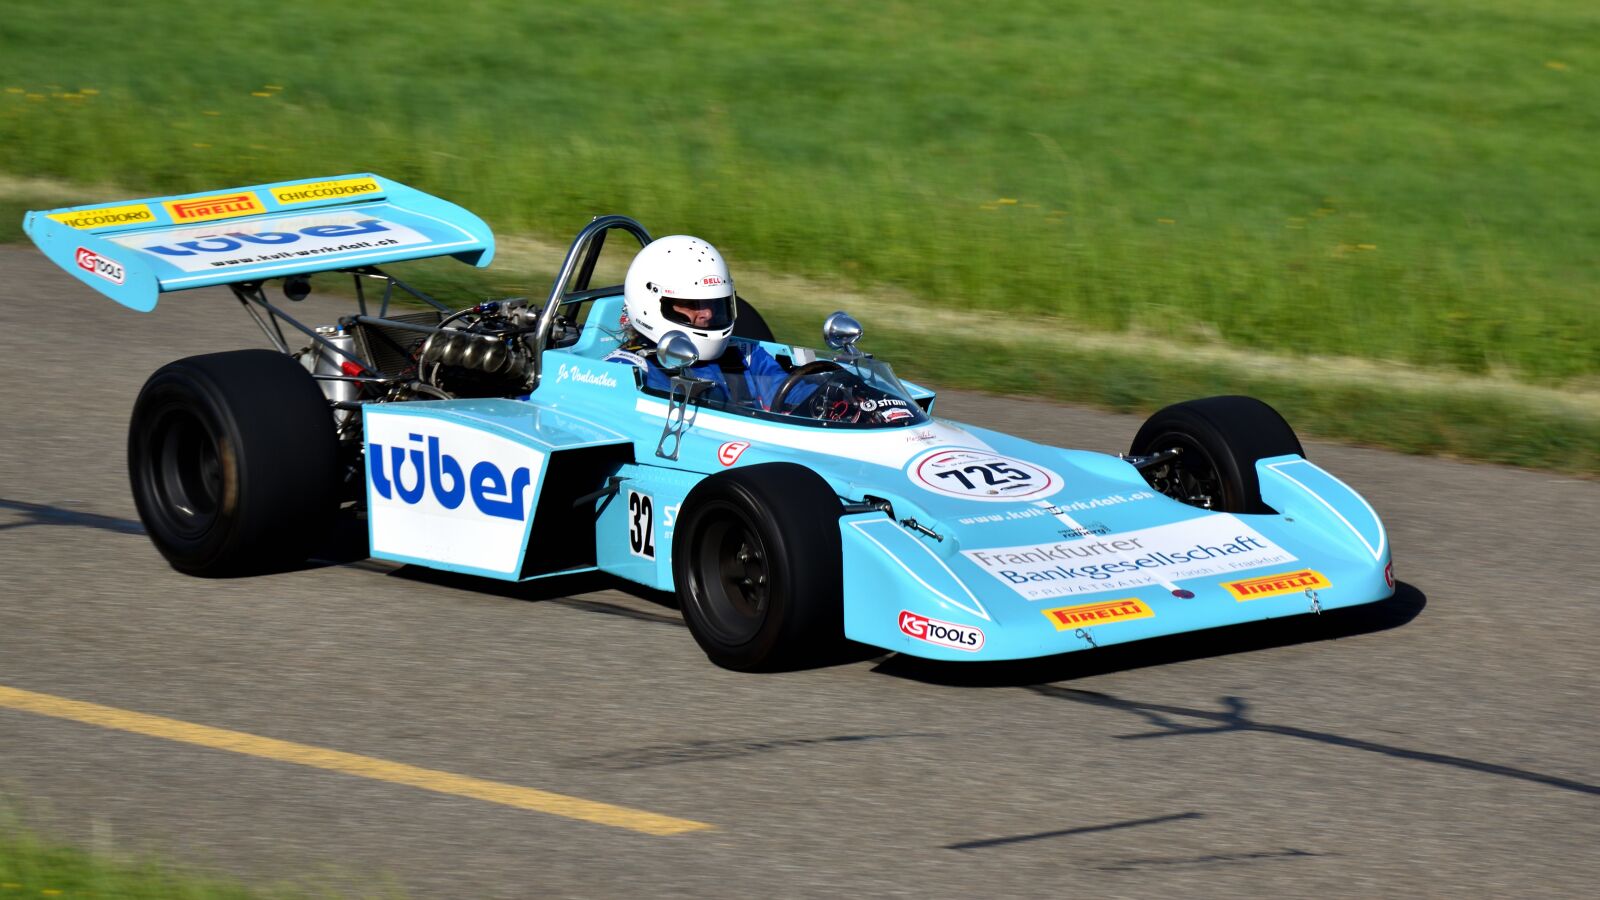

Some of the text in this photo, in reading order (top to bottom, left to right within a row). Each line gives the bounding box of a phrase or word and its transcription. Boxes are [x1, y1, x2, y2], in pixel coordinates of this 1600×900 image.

[278, 183, 377, 202] CHICCODORO
[172, 195, 256, 219] PIRELLI
[78, 250, 122, 279] KS TOOLS
[703, 277, 721, 285] BELL
[556, 363, 617, 388] Jo Vonlanthen
[935, 462, 1032, 490] 725
[629, 491, 655, 557] 32
[971, 537, 1145, 567] Frankfurter
[1000, 536, 1267, 584] Bankgesellschaft
[1028, 577, 1155, 597] PRIVATBANK
[1231, 571, 1321, 596] PIRELLI
[1052, 600, 1142, 625] PIRELLI
[901, 614, 977, 646] KS TOOLS
